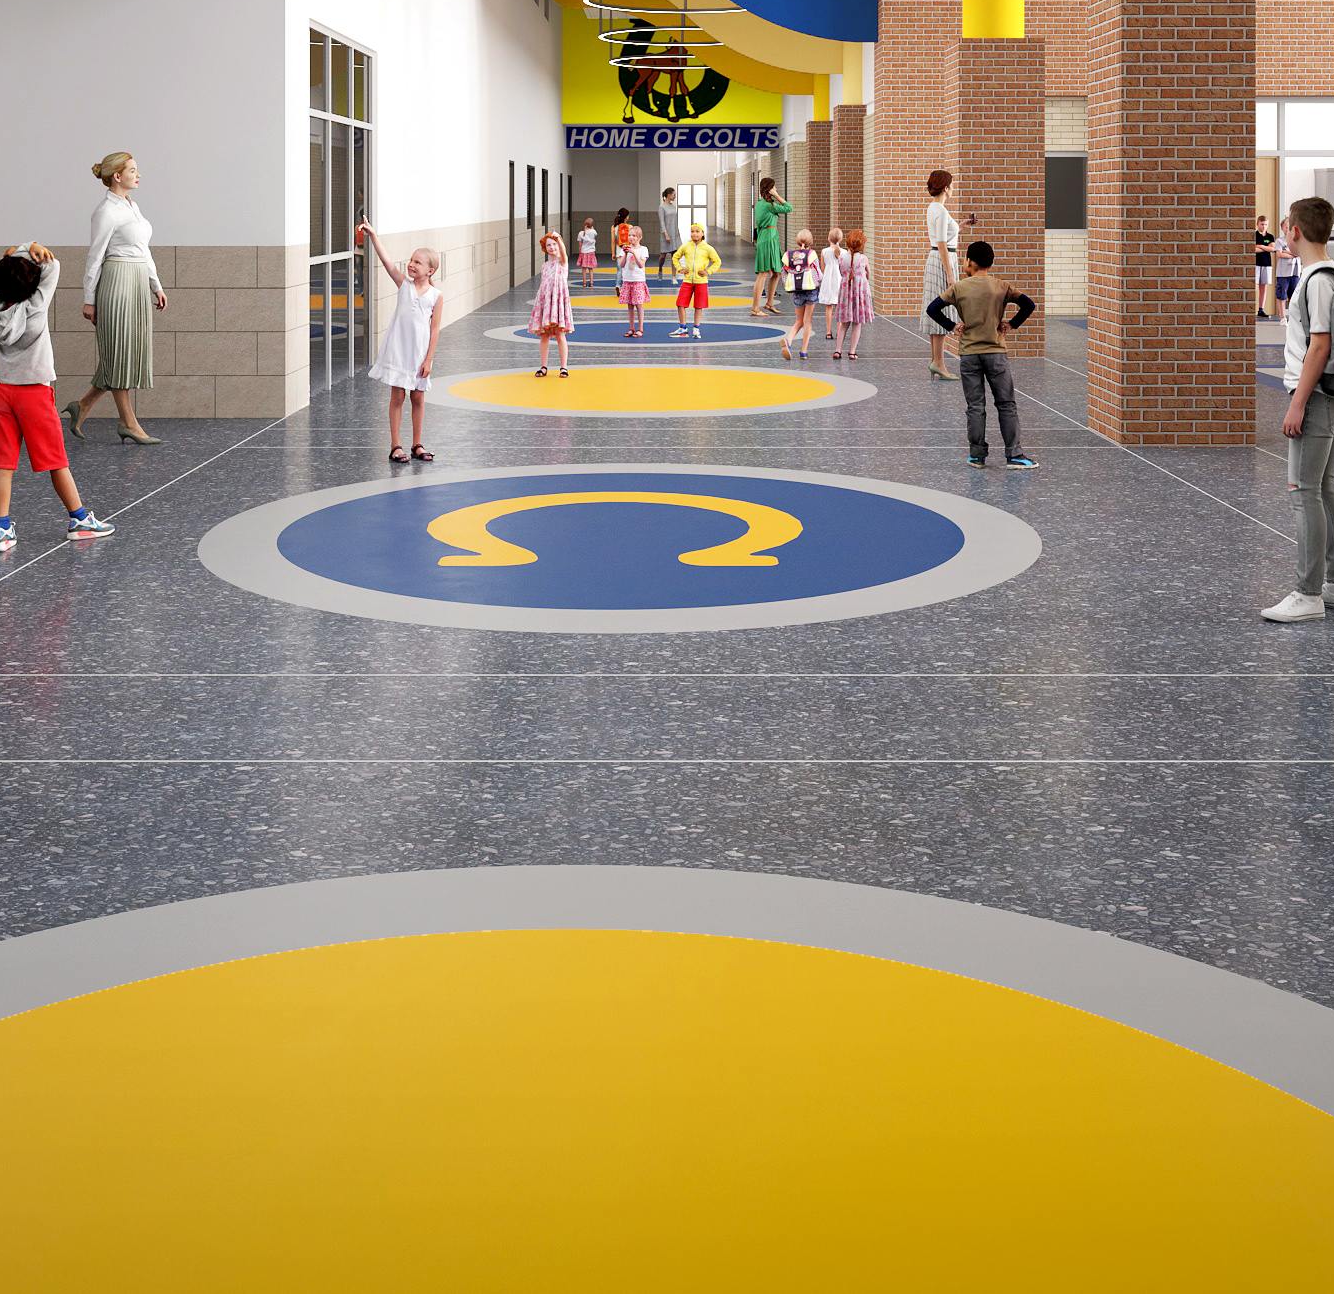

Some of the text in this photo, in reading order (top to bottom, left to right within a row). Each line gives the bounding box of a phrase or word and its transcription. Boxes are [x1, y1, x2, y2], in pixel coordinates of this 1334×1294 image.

[569, 128, 779, 148] HOME OF COLTS
